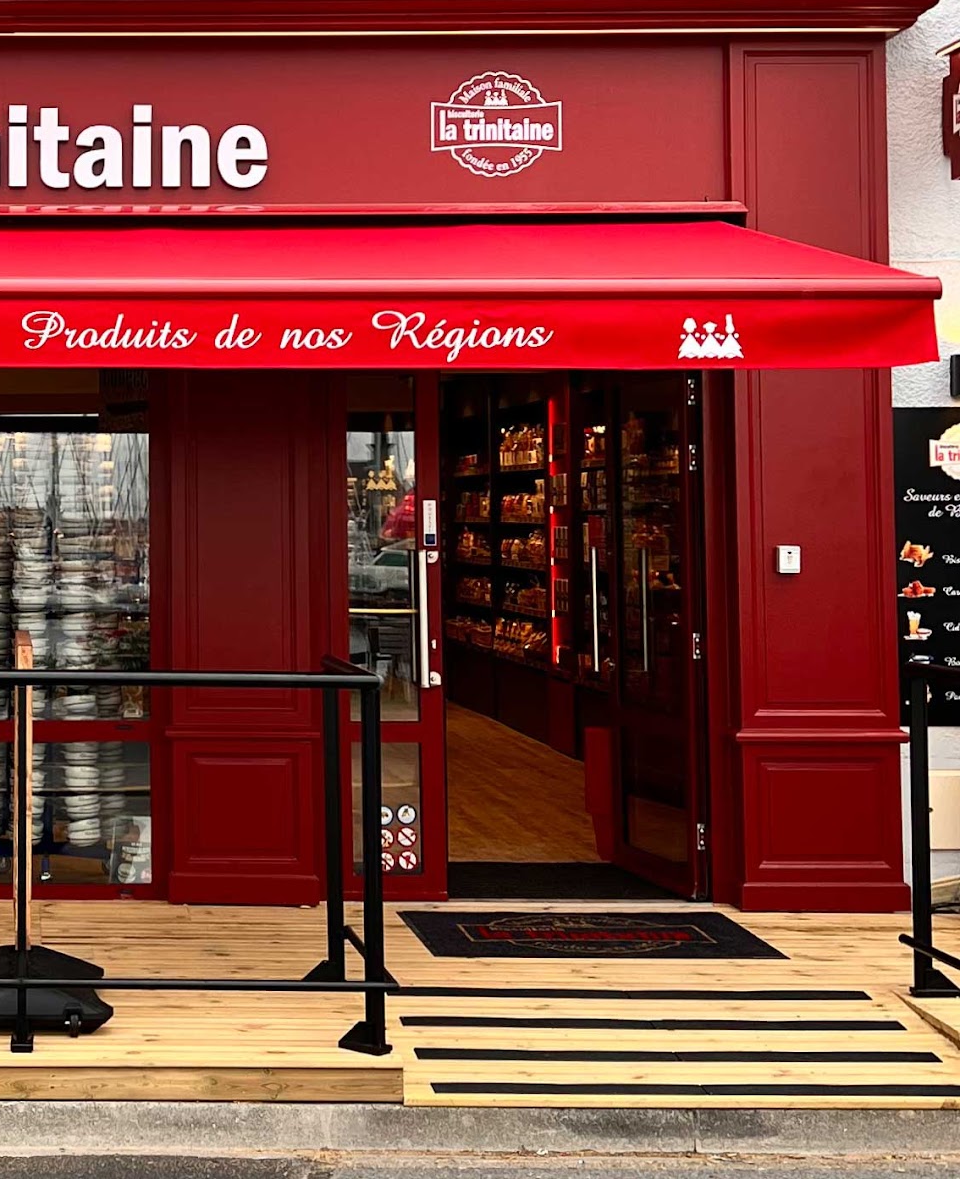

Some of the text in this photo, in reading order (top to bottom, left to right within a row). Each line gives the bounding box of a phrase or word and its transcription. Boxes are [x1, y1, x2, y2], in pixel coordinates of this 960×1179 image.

[458, 77, 532, 104] Maison familiale
[439, 109, 554, 142] la trinitaine
[461, 147, 533, 172] fondée en 1955
[21, 310, 198, 350] Produits
[214, 313, 262, 349] de
[279, 328, 353, 349] nos
[371, 311, 554, 363] Régions
[934, 444, 944, 462] la
[903, 487, 952, 502] Saveurs
[928, 505, 944, 518] de
